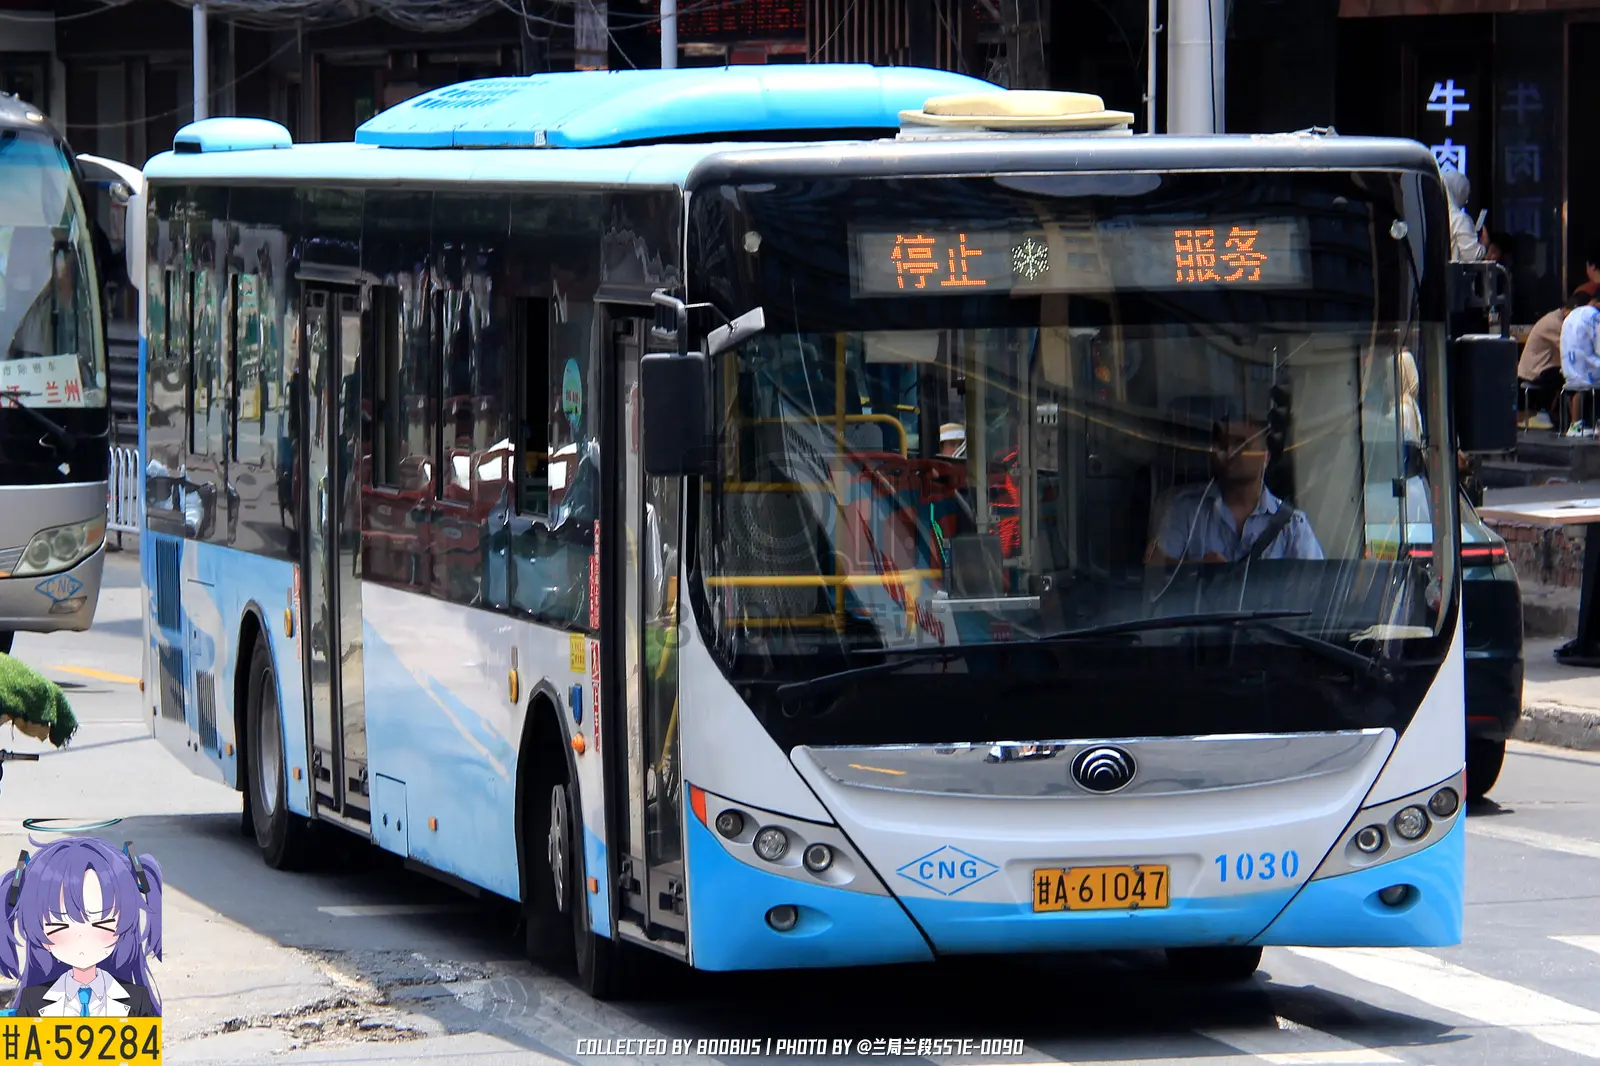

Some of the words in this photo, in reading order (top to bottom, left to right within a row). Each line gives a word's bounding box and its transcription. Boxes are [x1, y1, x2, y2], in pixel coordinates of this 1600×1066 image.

[891, 232, 987, 289] 停止
[1174, 225, 1268, 284] 服务
[46, 378, 81, 404] 兰州
[918, 859, 977, 882] CNG
[1215, 850, 1300, 882] 1030
